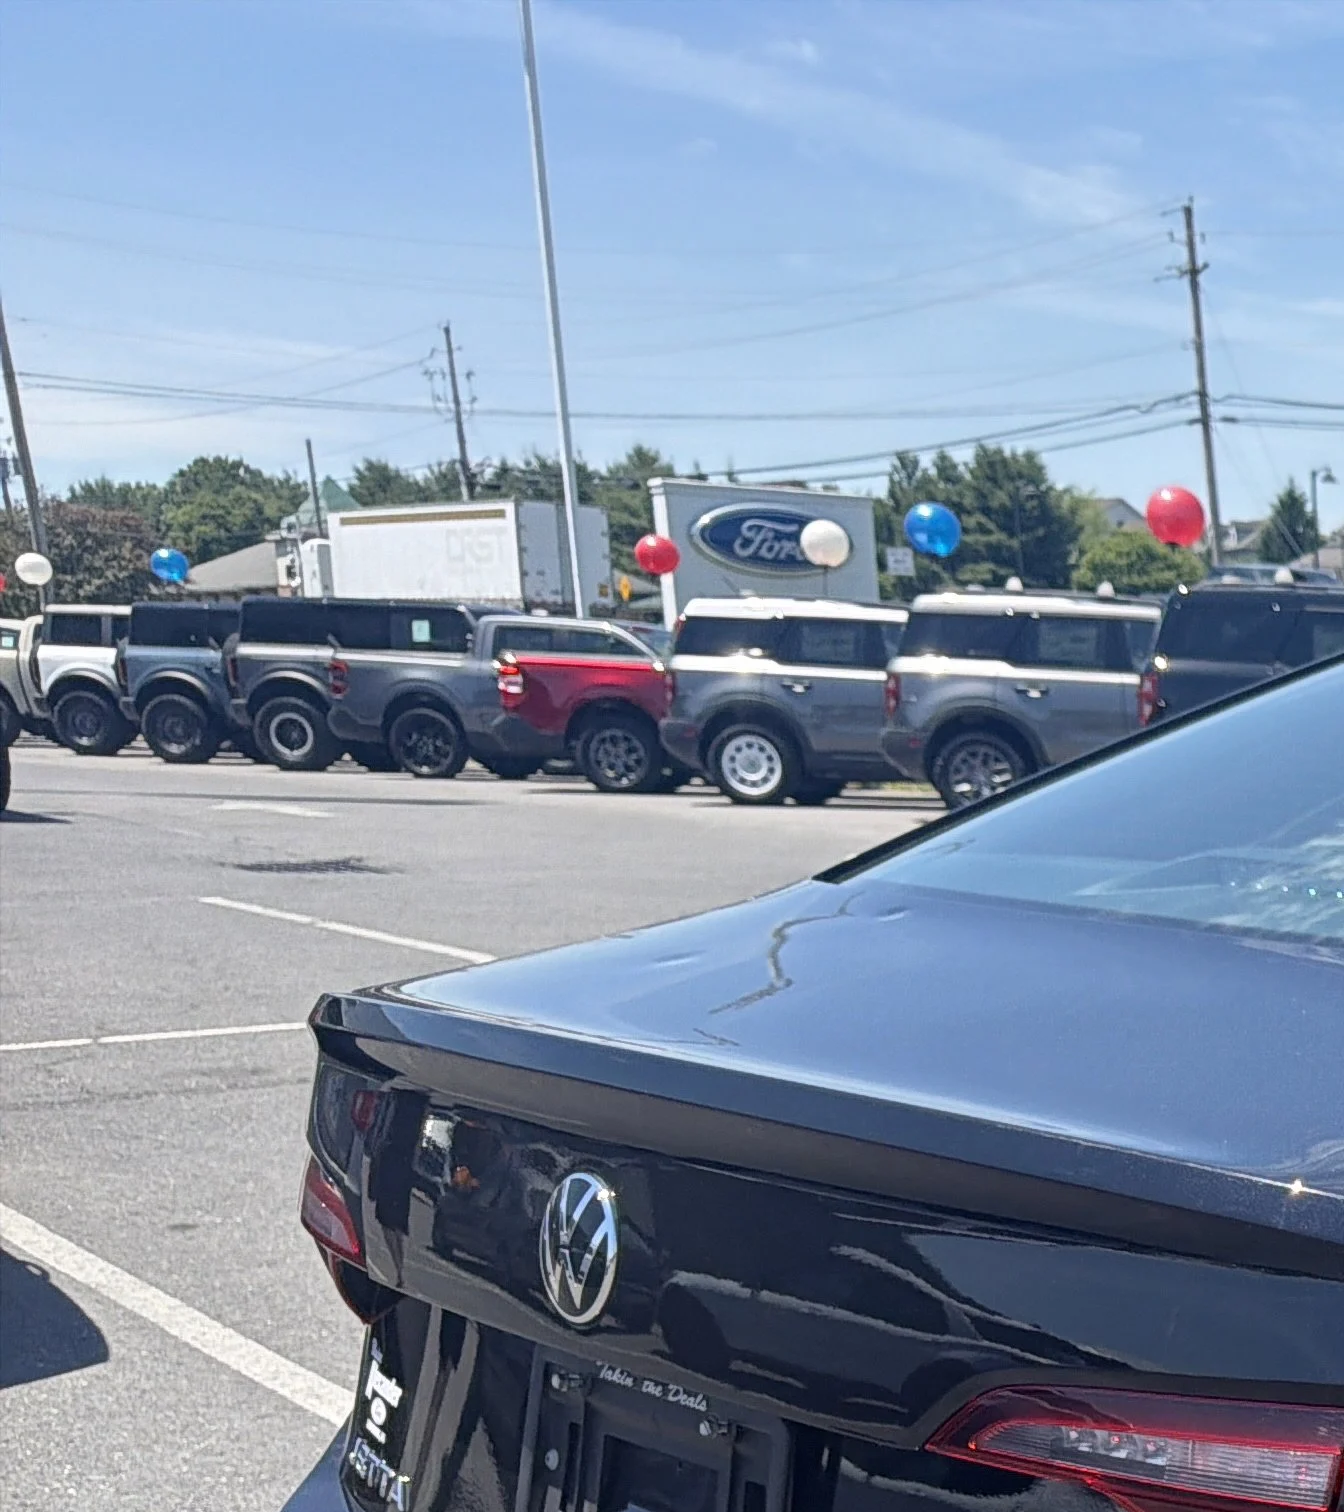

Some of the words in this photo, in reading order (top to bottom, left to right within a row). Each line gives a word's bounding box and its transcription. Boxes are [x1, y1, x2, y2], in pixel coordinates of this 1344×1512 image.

[733, 518, 807, 560] For
[641, 1380, 663, 1398] the
[667, 1383, 708, 1413] Deals
